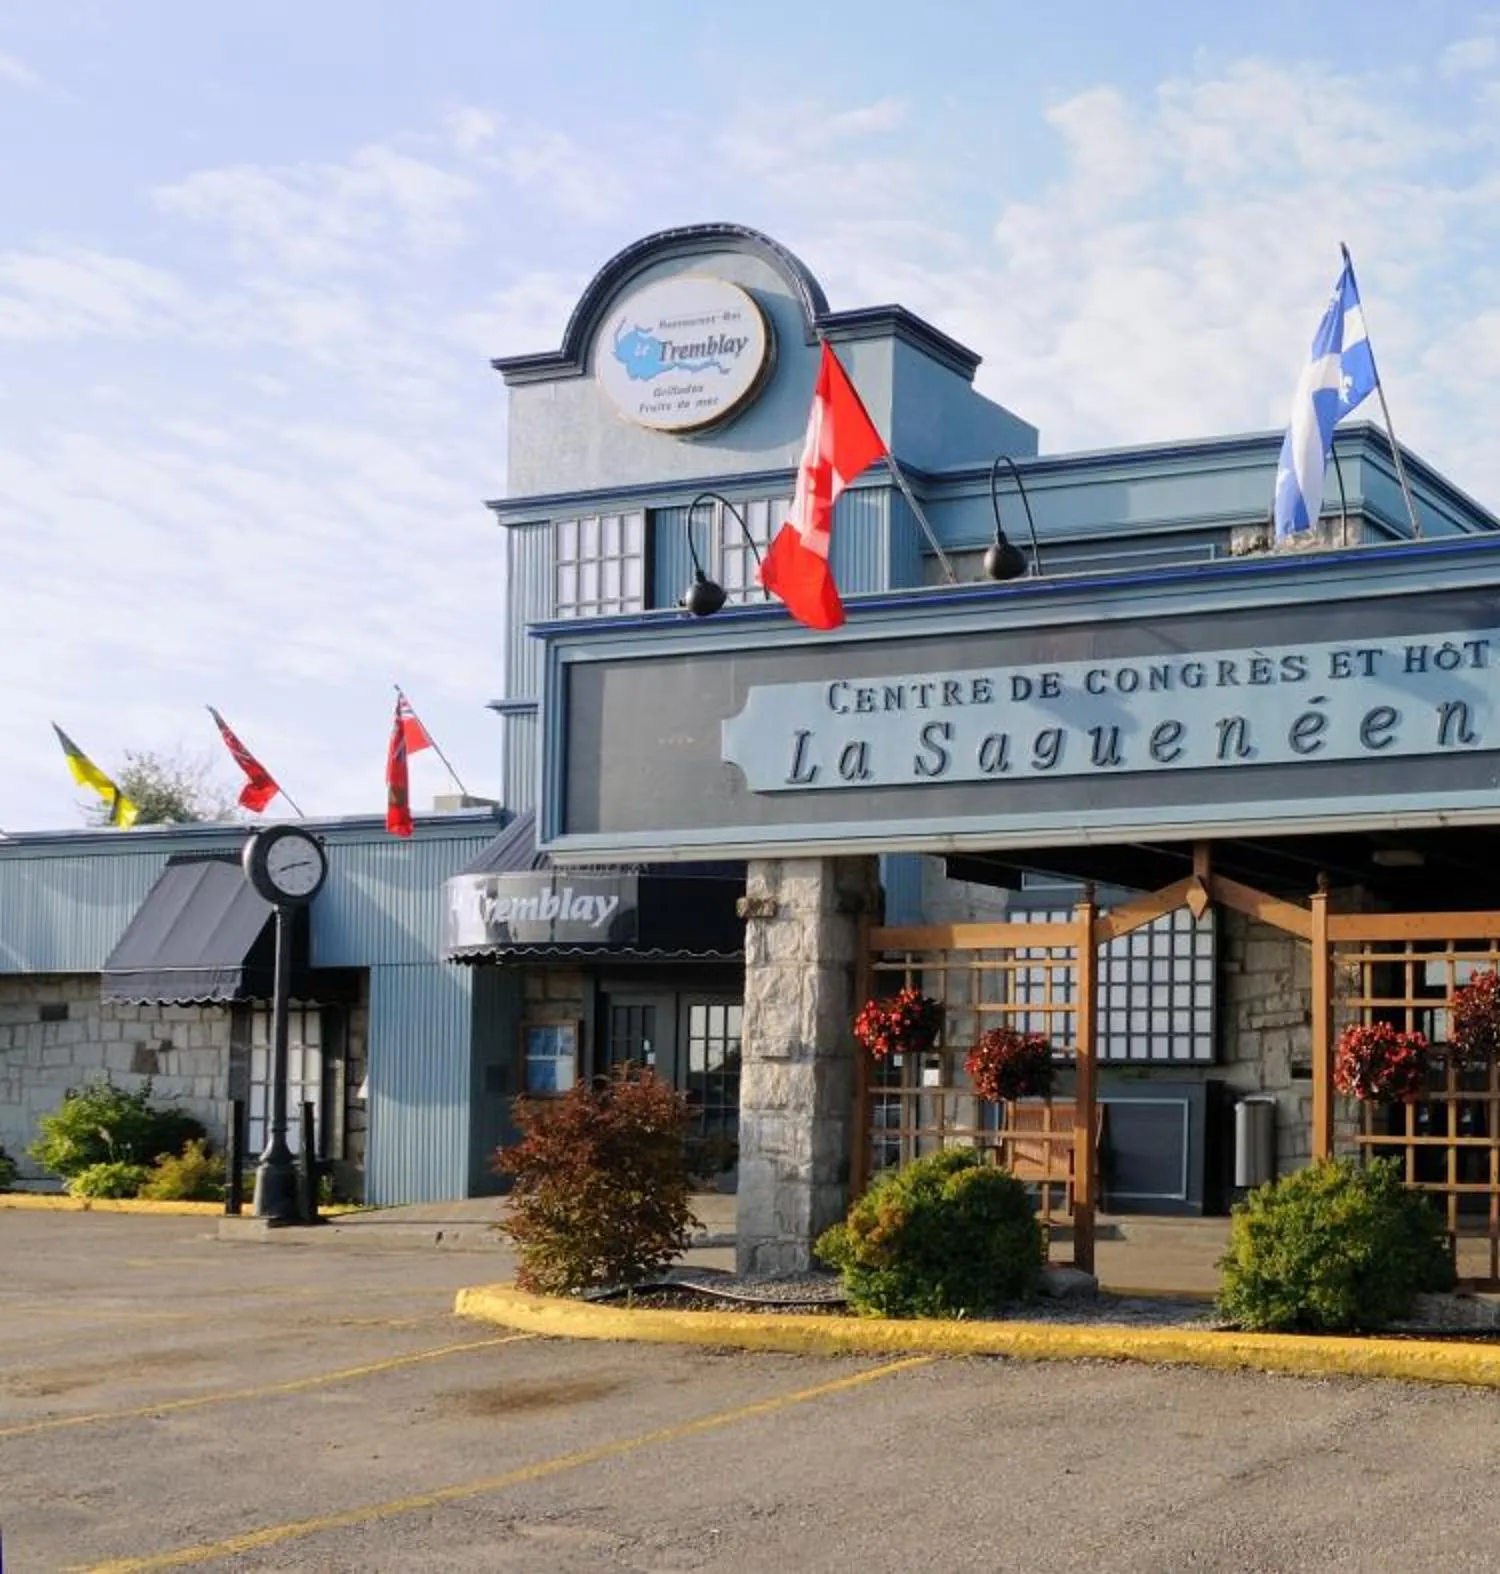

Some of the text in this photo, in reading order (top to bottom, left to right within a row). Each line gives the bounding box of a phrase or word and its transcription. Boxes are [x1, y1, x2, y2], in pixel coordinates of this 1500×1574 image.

[658, 333, 749, 361] Tremblay
[827, 678, 993, 715] CENTRE
[1009, 672, 1062, 702] DE
[1085, 650, 1309, 696] CONGRÈS
[1327, 649, 1383, 679] ET
[785, 728, 872, 785] La
